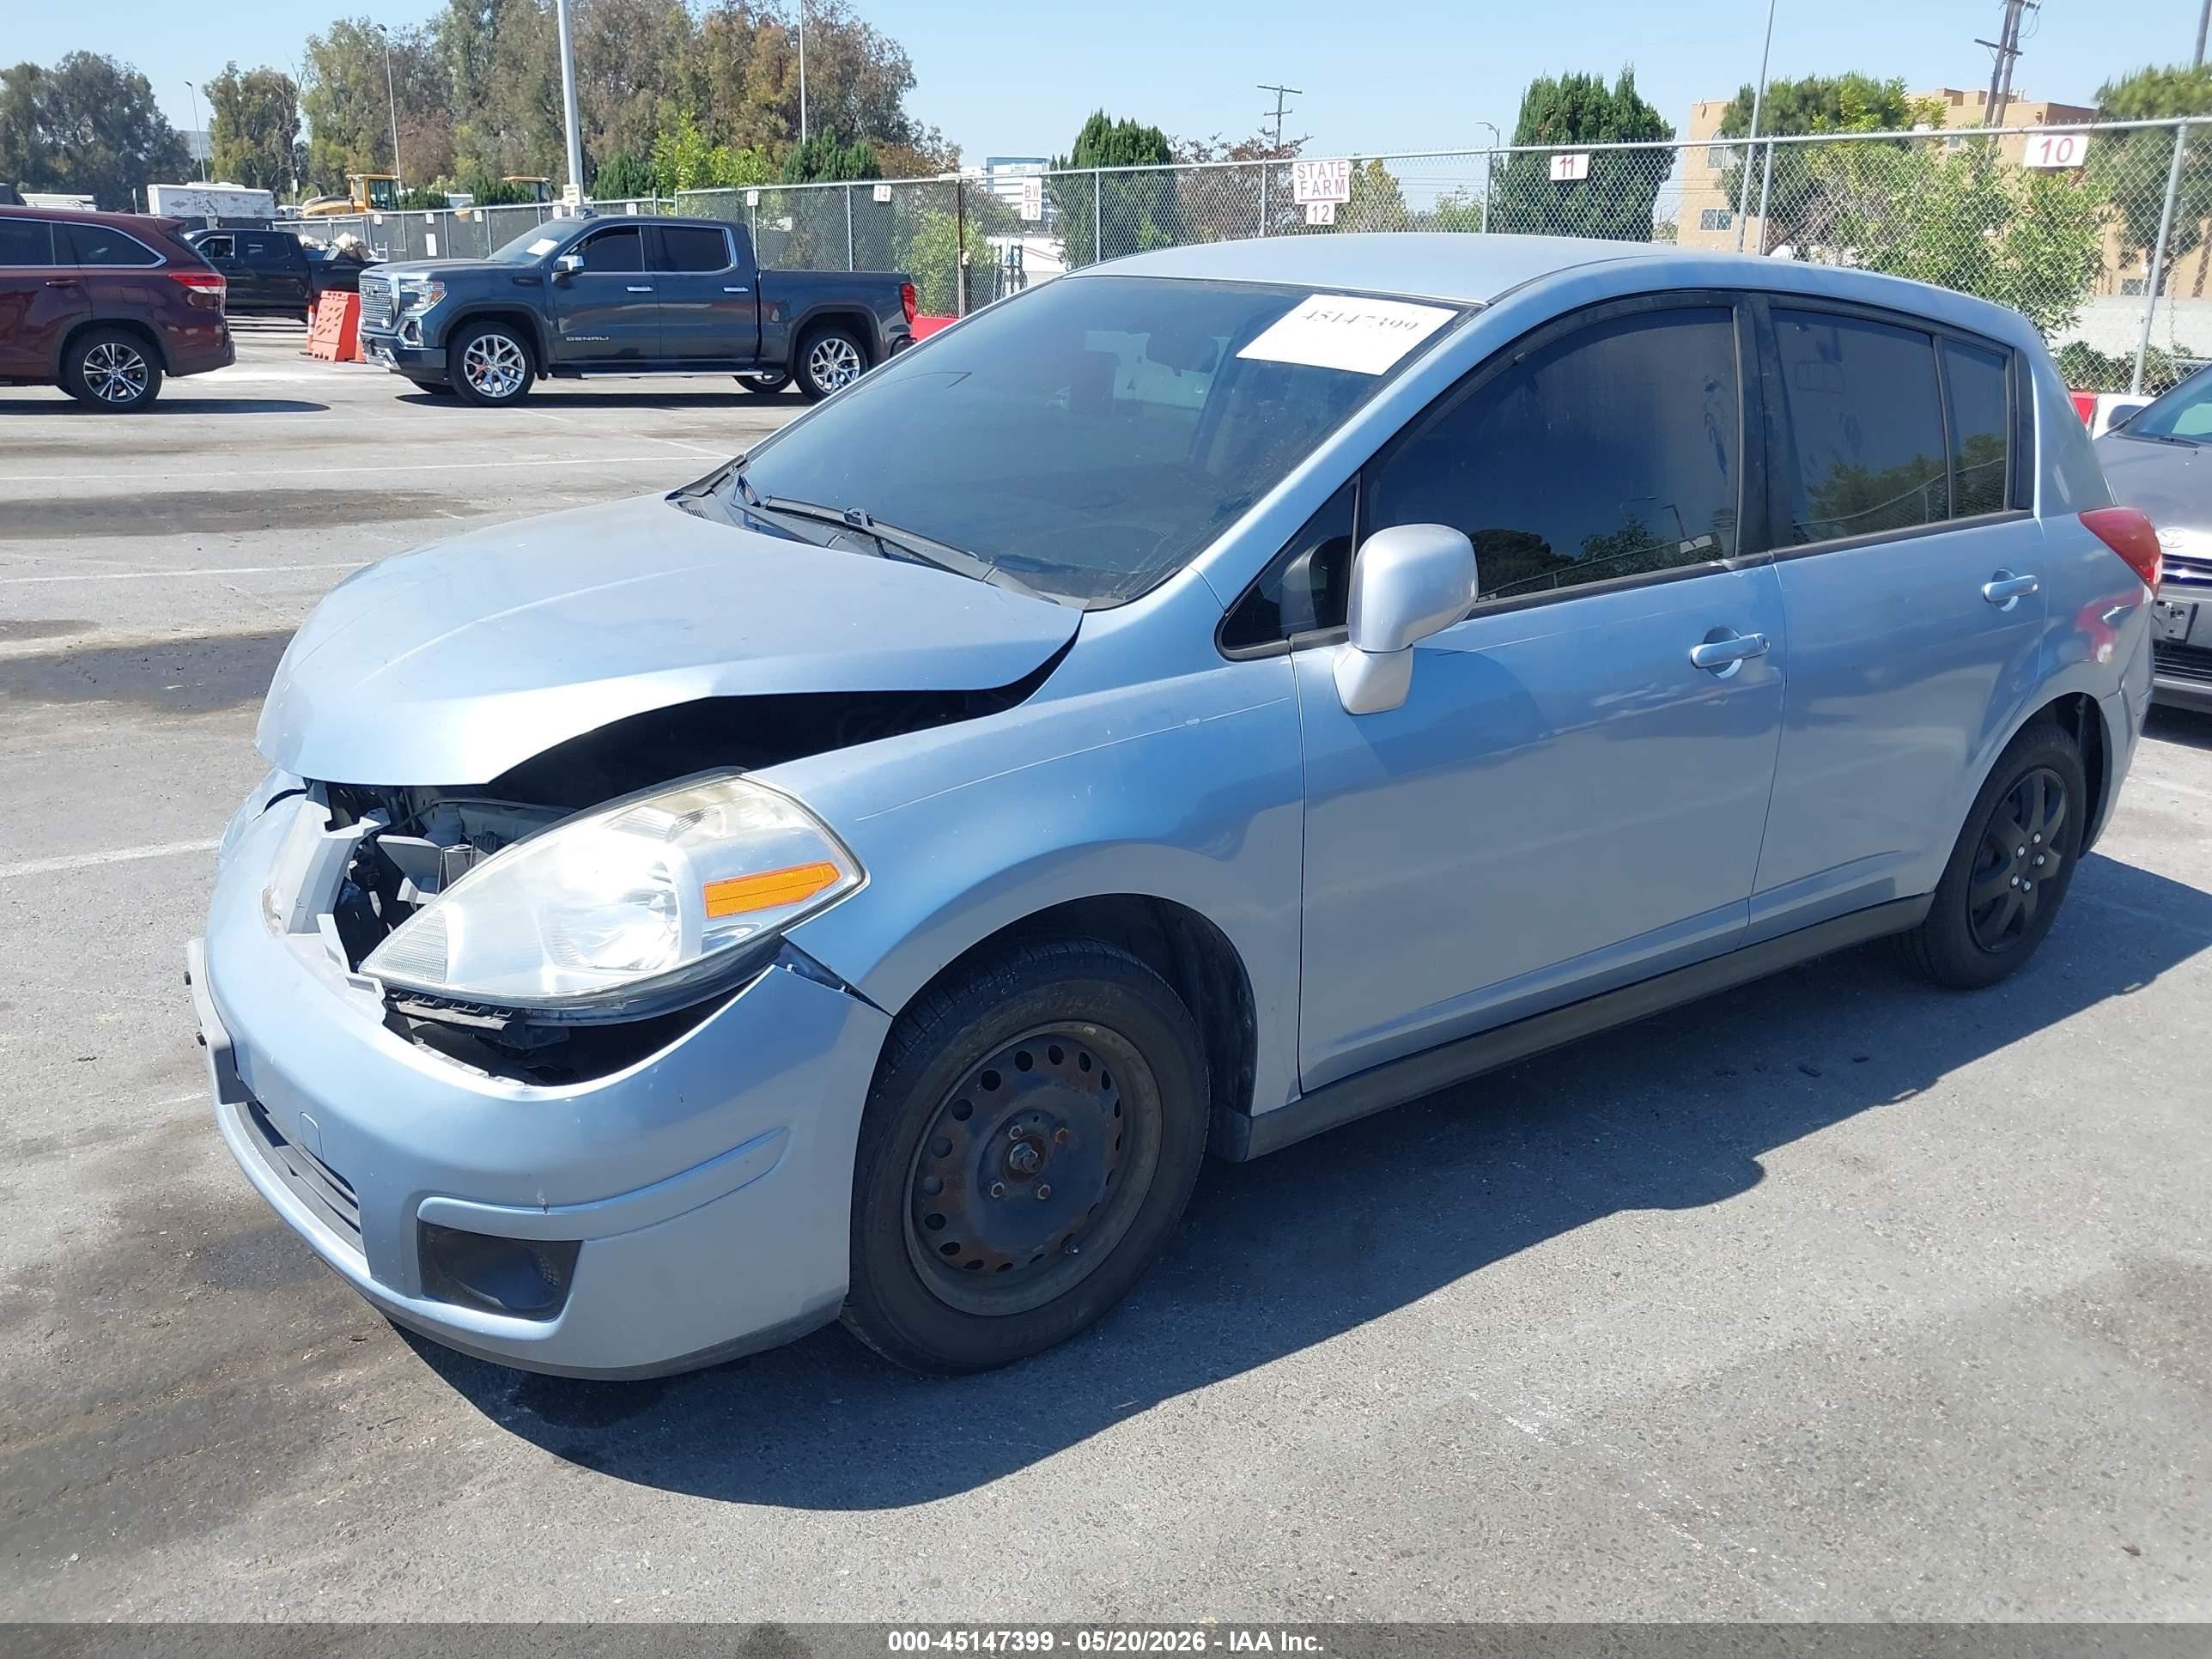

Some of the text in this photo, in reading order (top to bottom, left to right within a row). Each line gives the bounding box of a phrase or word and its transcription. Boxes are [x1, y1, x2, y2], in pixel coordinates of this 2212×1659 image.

[2040, 137, 2074, 164] 10
[1297, 161, 1347, 179] STATE
[1559, 156, 1574, 178] 11
[1024, 185, 1039, 198] BW
[1300, 179, 1346, 197] FARM
[1026, 203, 1038, 218] 13
[1312, 204, 1329, 222] 12
